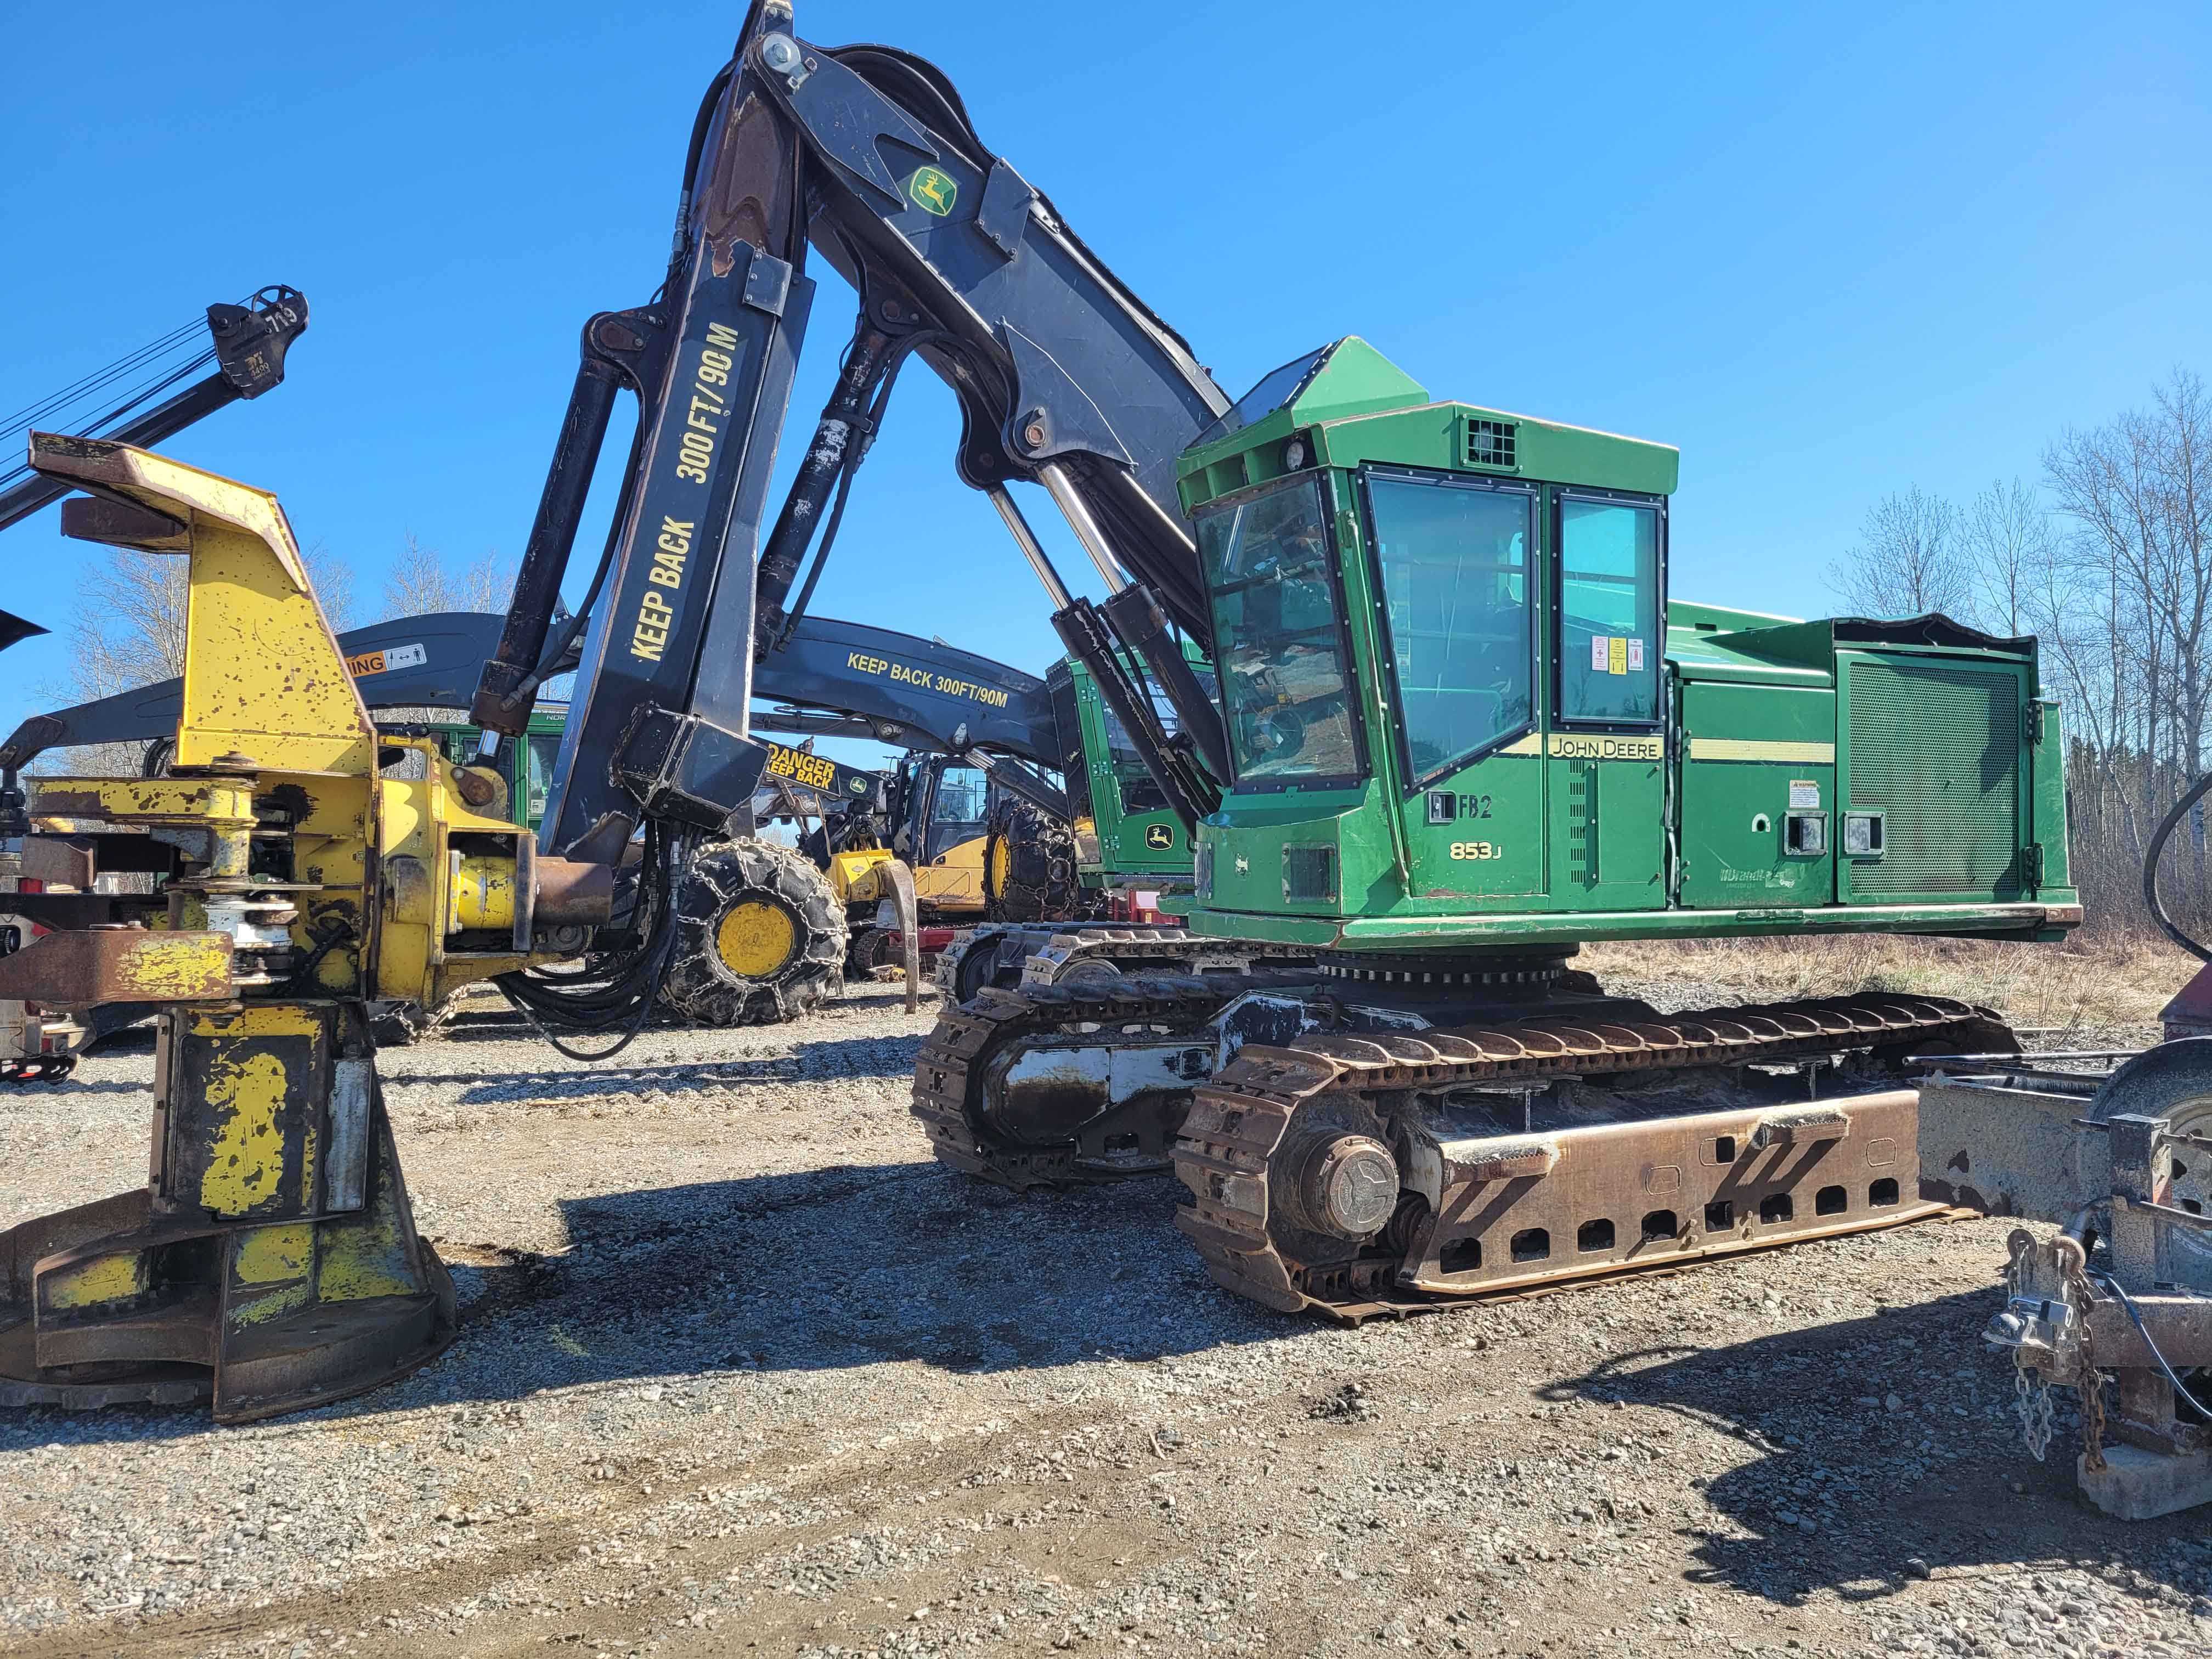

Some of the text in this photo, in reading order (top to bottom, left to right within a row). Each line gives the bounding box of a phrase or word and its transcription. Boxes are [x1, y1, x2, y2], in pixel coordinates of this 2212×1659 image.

[265, 308, 297, 332] 719
[650, 515, 695, 589] BACK
[631, 592, 673, 661] KEEP
[847, 652, 1008, 708] KEEP BACK 300FT/90M
[769, 744, 835, 778] DANGER
[1553, 738, 1657, 757] JOHN DEERE
[796, 769, 832, 790] BACK
[1449, 840, 1502, 860] 853J
